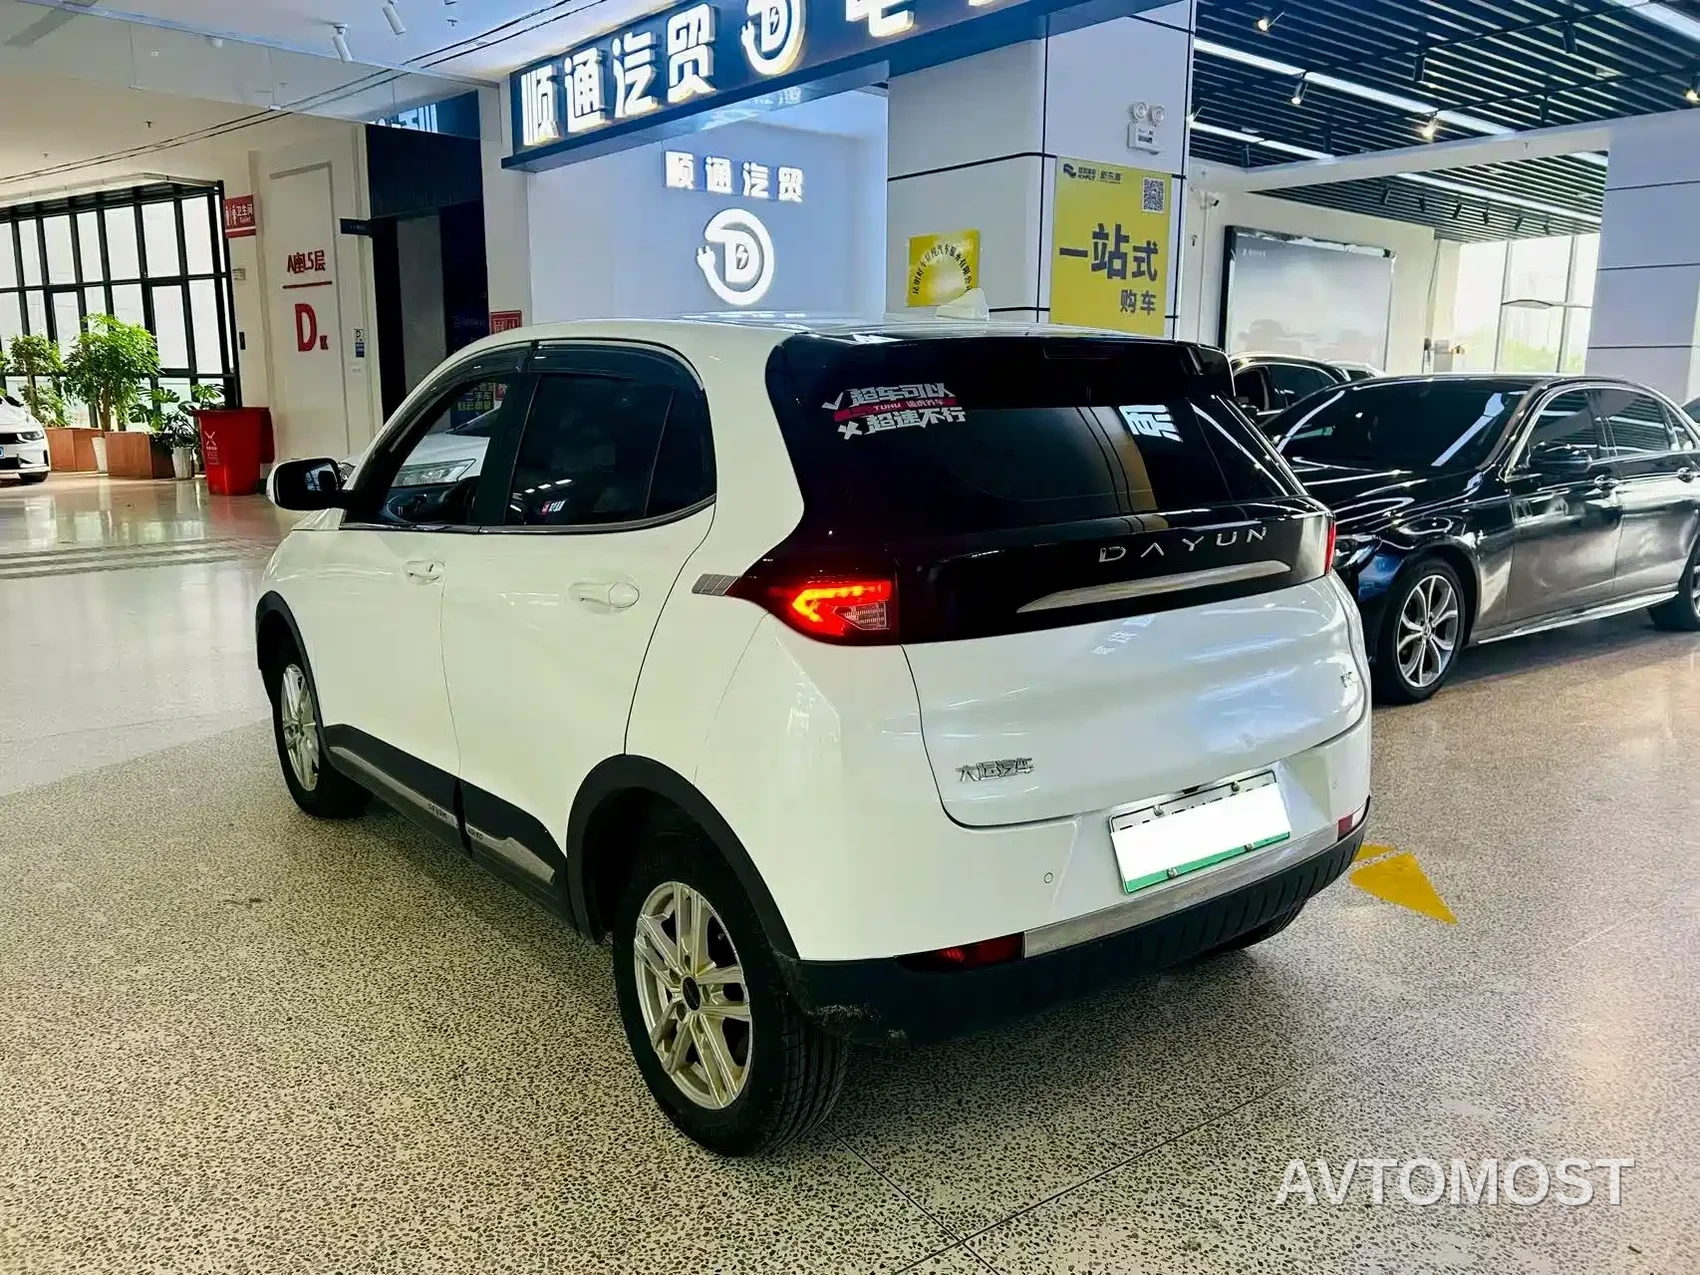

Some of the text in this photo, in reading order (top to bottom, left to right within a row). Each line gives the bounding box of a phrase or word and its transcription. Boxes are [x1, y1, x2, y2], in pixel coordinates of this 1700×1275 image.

[520, 3, 717, 147] 顺通汽贸
[665, 150, 803, 203] 顺通汽贸
[1059, 222, 1159, 282] 一站式
[1120, 289, 1157, 315] 购车
[846, 382, 957, 408] 超车可以
[872, 402, 902, 411] TUHU
[862, 406, 966, 436] 超速不行
[1098, 526, 1268, 563] DAYUN
